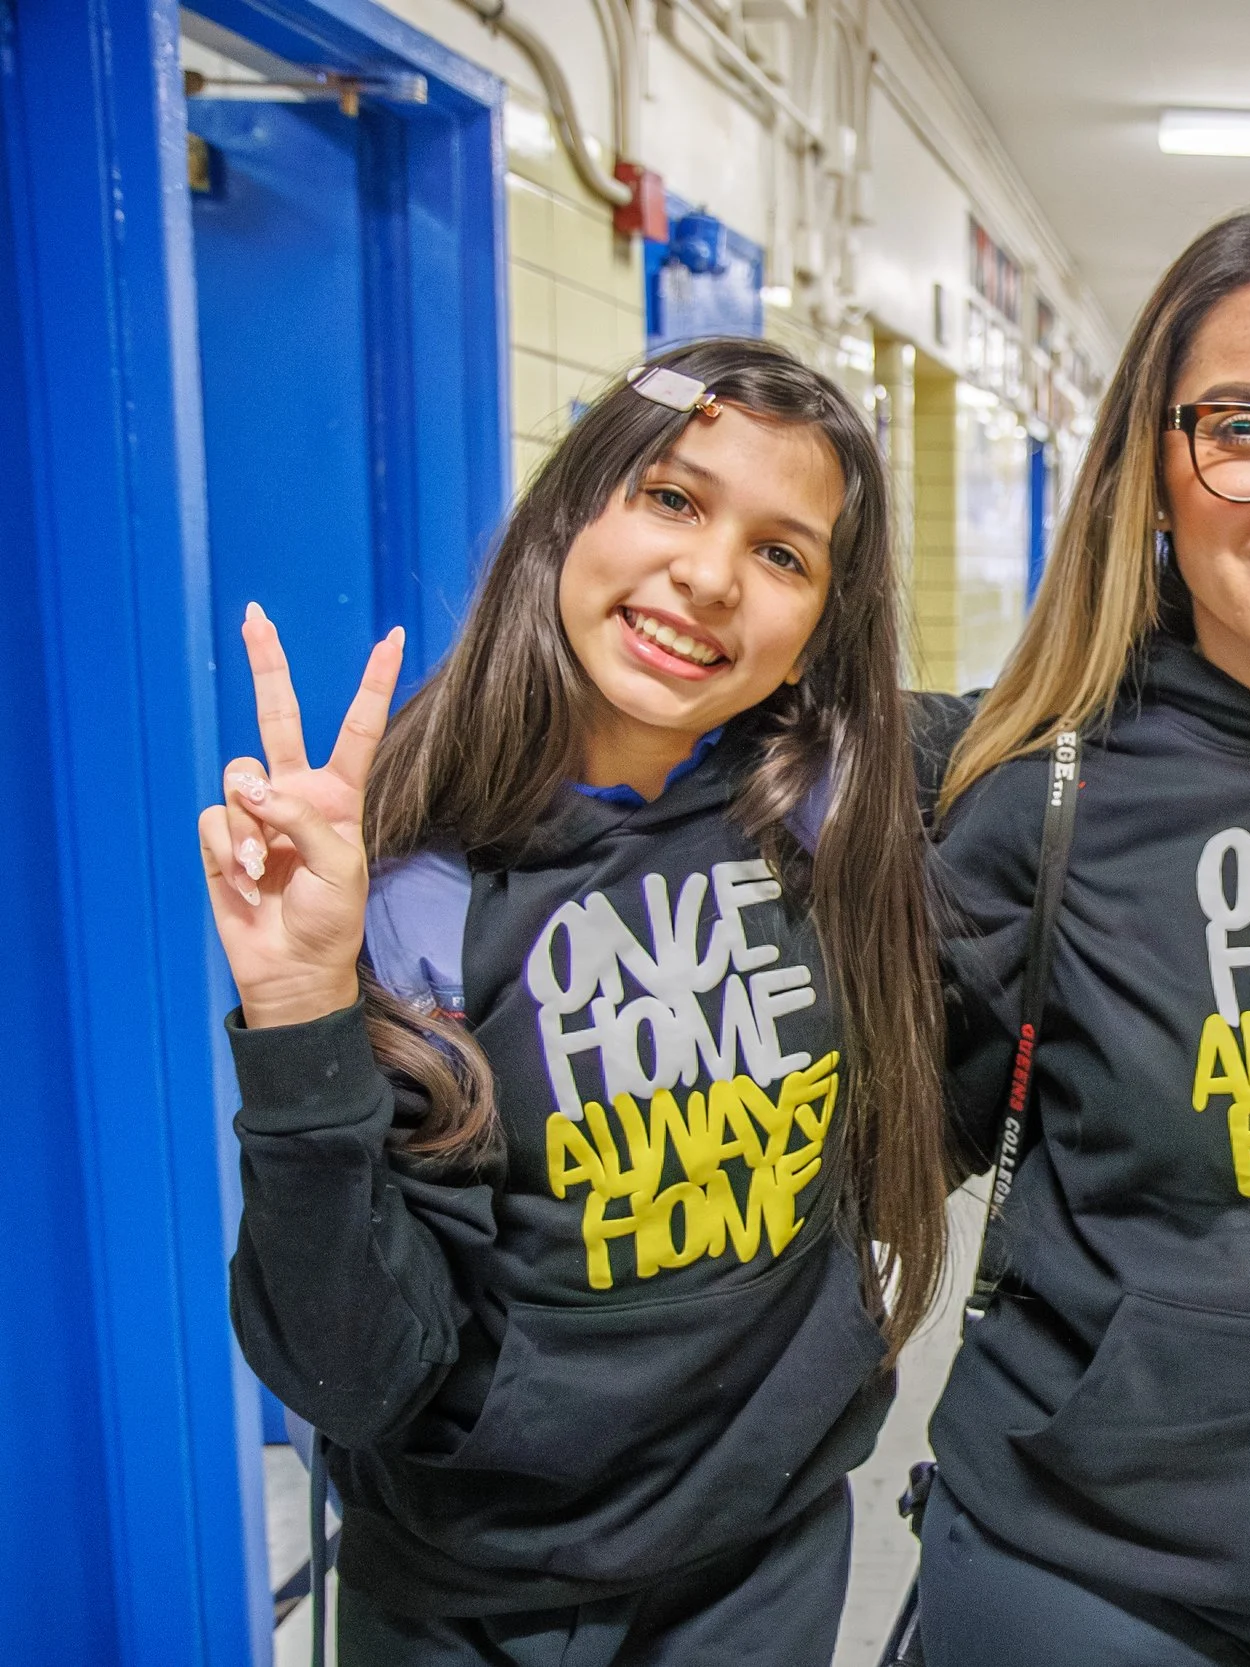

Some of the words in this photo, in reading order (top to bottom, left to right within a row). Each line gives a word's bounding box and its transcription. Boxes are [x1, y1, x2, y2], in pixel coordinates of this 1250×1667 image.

[527, 859, 782, 1013] ONCE
[538, 965, 816, 1121] HOME
[1009, 1023, 1035, 1111] QUEENS
[546, 1050, 840, 1198] ALWAYS
[993, 1117, 1020, 1204] COLLEGE
[582, 1140, 822, 1289] HOME
